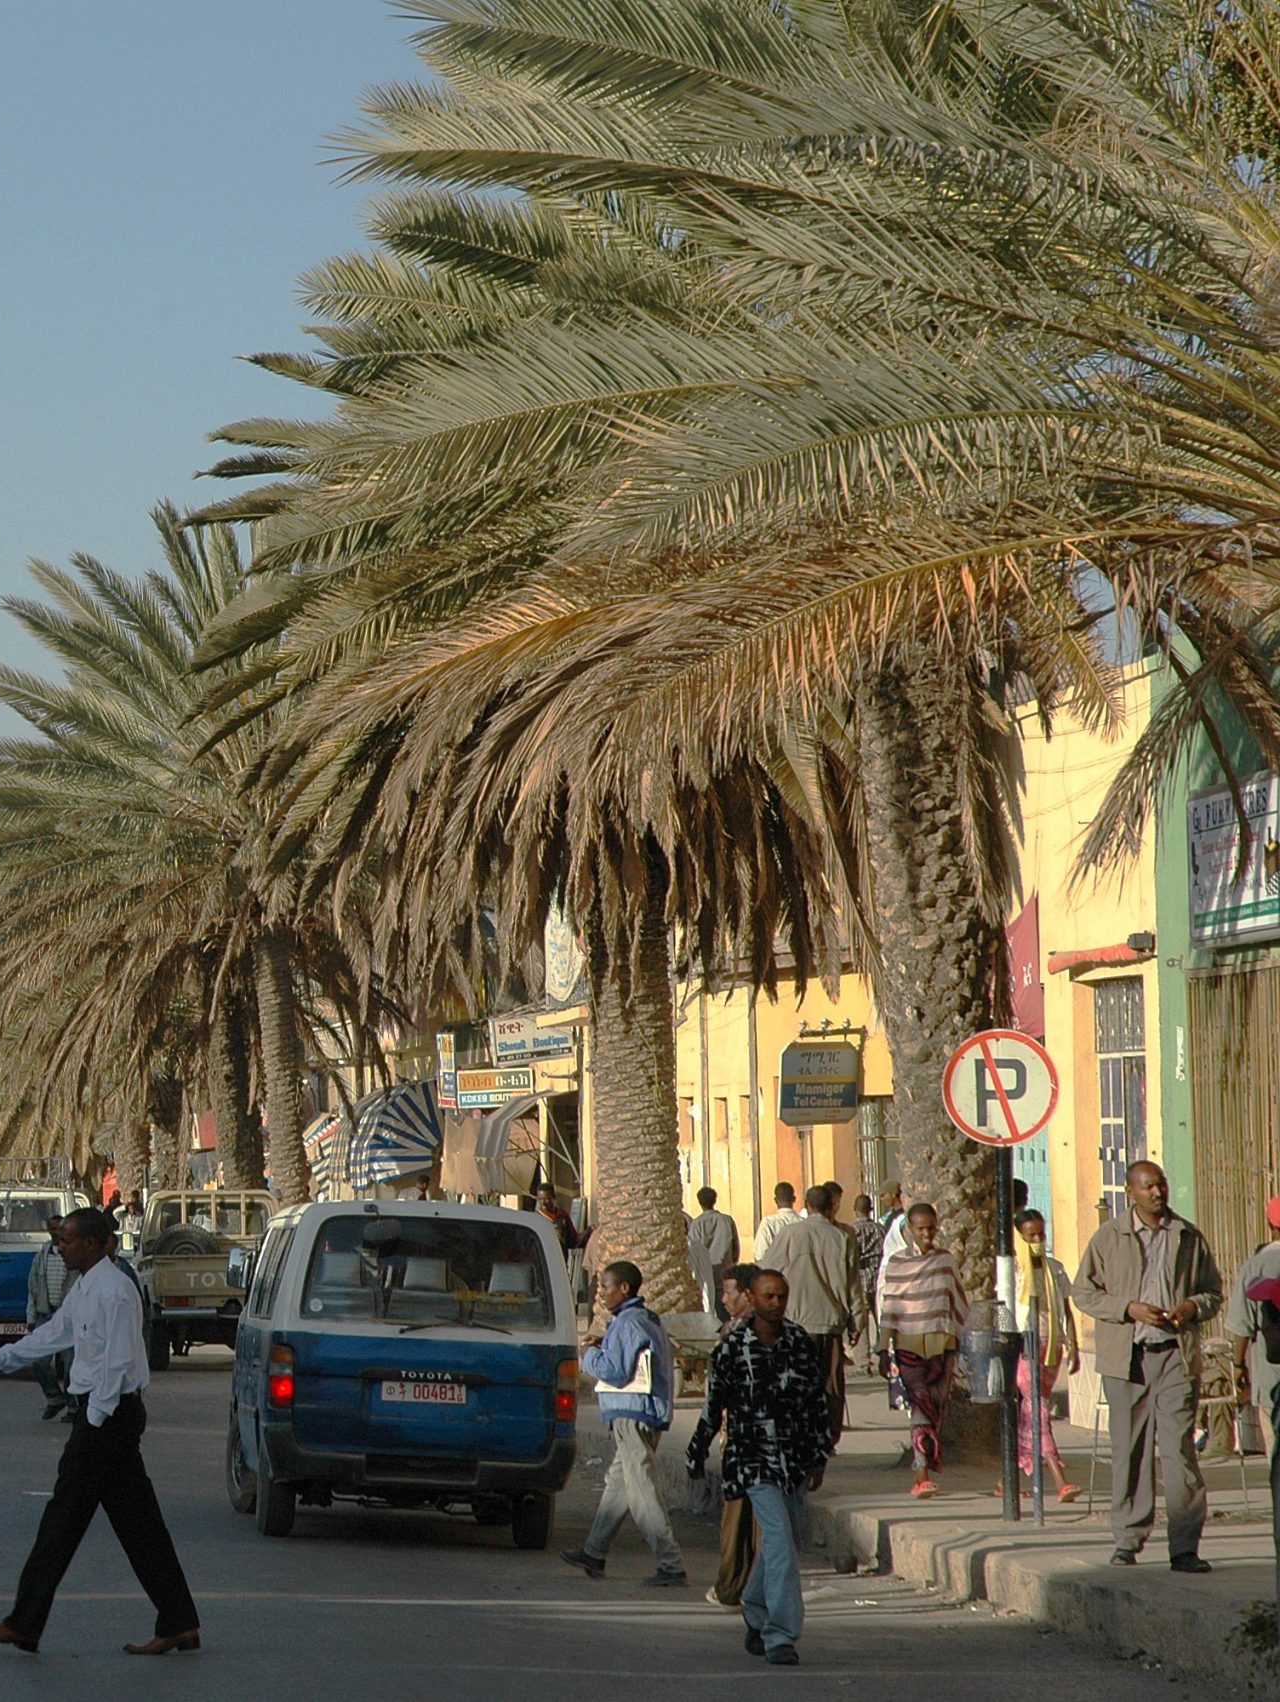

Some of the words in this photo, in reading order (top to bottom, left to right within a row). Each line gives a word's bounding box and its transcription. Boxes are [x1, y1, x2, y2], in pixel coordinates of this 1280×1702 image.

[1206, 788, 1267, 827] FURNIRES
[532, 1035, 569, 1050] Boutique
[795, 1083, 845, 1097] Mamiger
[974, 1058, 1027, 1127] P
[461, 1093, 488, 1103] KOKEB
[793, 1096, 809, 1107] Tel
[809, 1096, 844, 1107] Center
[185, 1271, 228, 1288] TOY
[400, 1370, 452, 1380] TOYOTA
[413, 1384, 456, 1401] 00481
